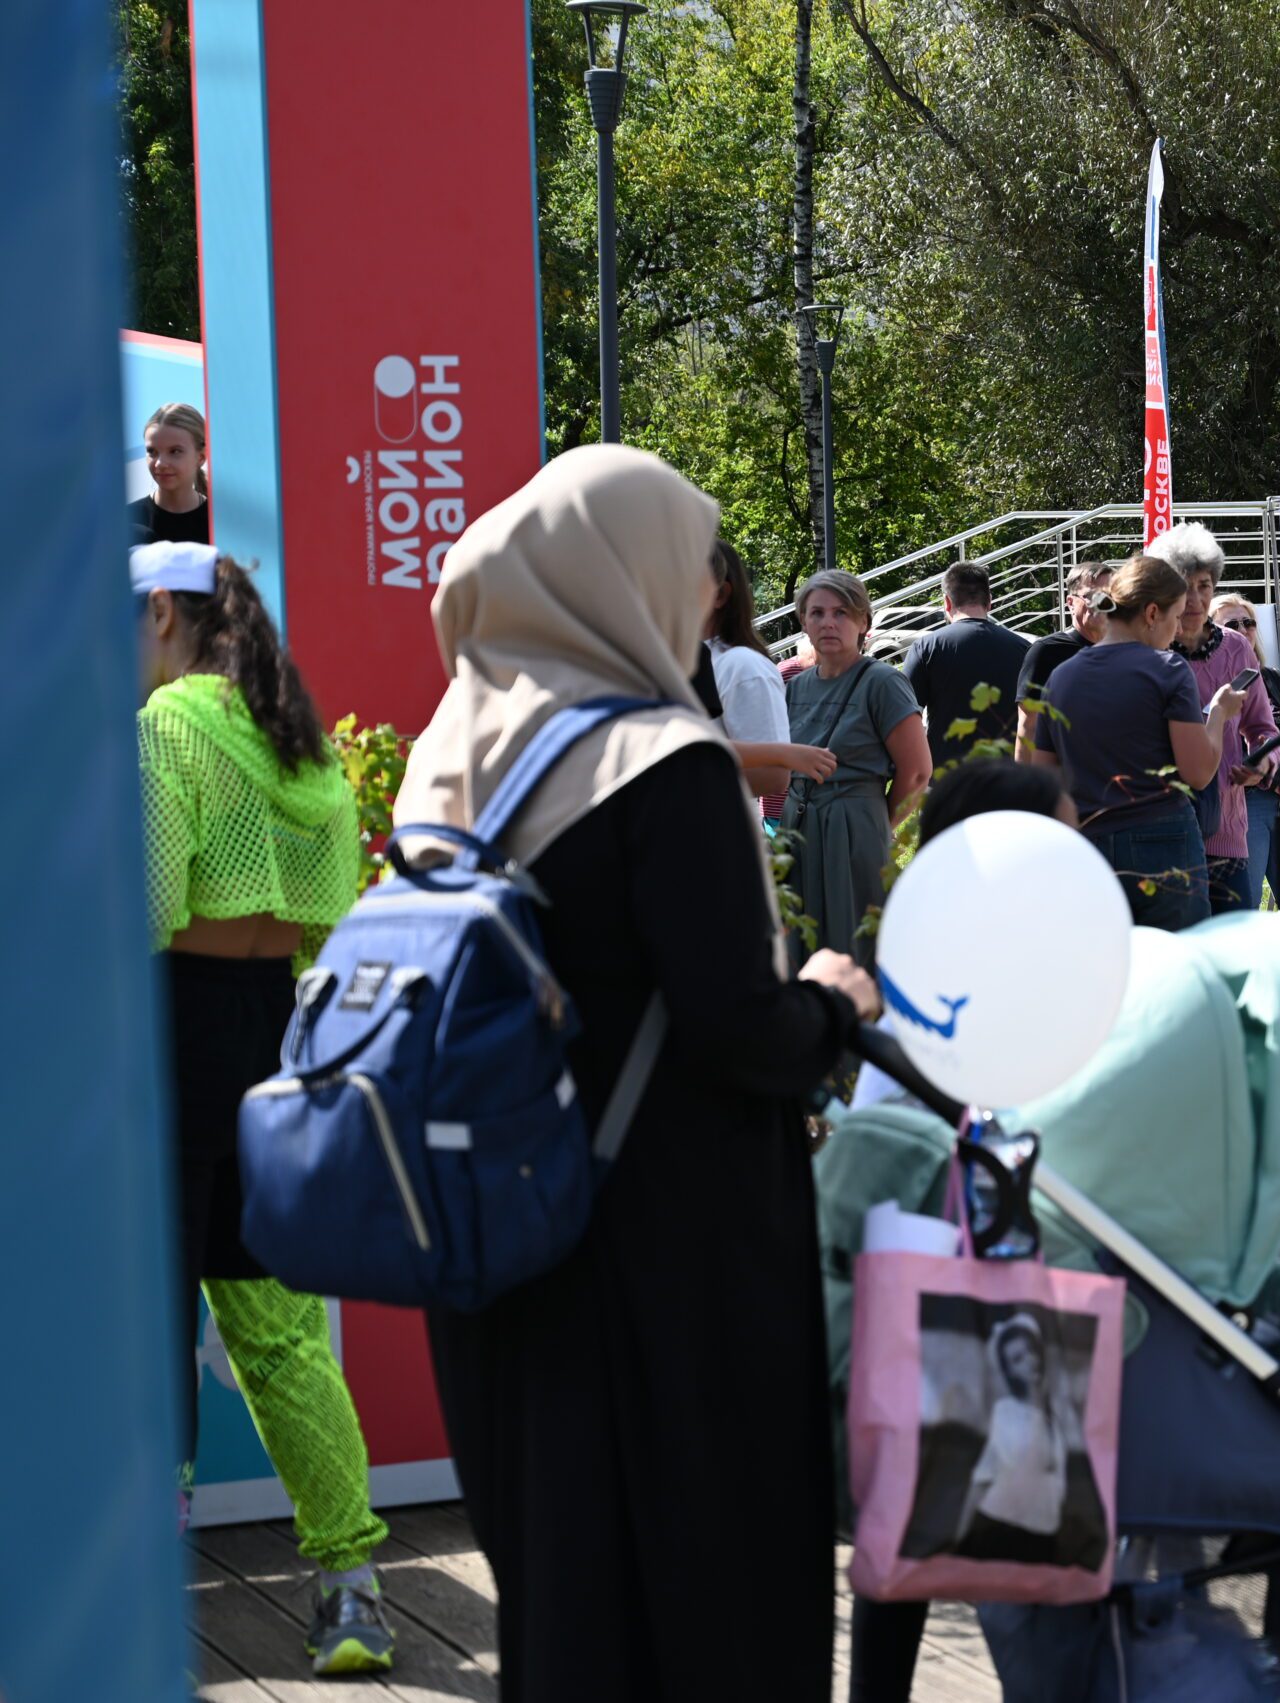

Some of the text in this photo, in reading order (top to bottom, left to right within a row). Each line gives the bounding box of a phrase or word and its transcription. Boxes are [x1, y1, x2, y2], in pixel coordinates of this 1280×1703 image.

[363, 450, 376, 585] ПРОГРАММА МЭРА МОСКВЫ
[1153, 439, 1169, 536] ОСКВЕ
